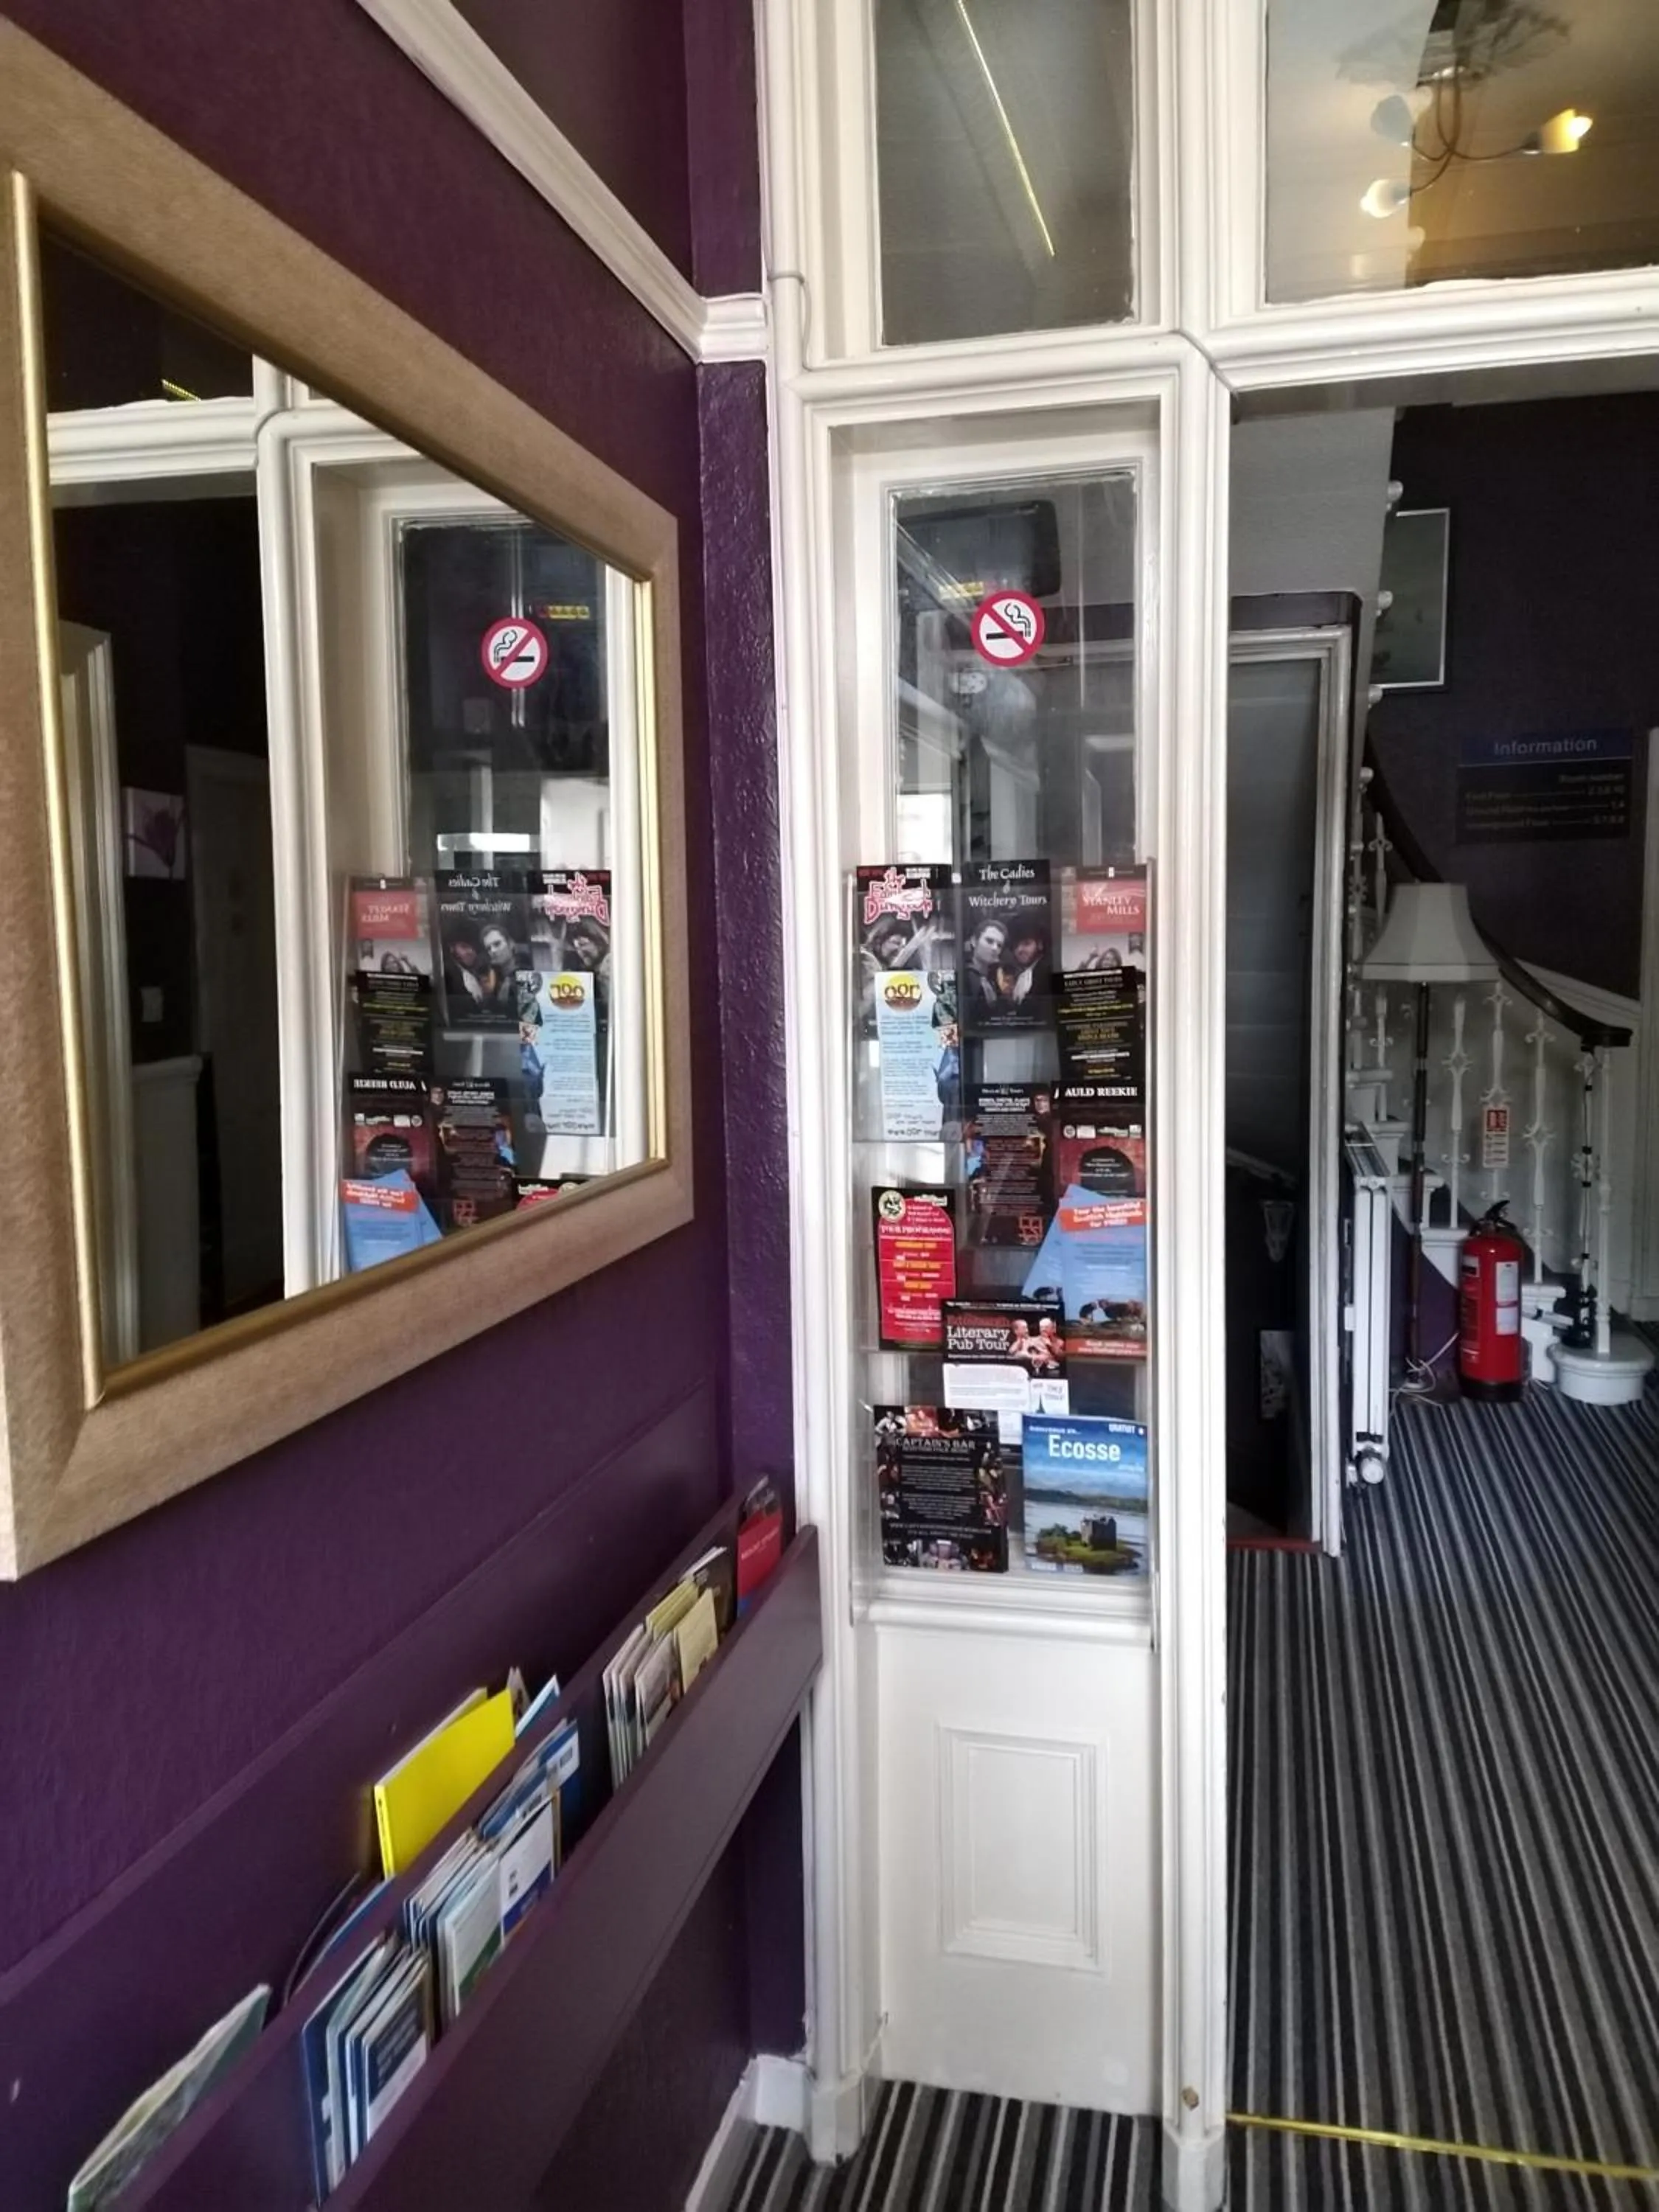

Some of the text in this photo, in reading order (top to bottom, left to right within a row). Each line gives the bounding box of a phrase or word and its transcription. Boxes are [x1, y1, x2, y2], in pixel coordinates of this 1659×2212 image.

[1493, 737, 1598, 756] Information
[978, 863, 1035, 881] The Cadies
[968, 890, 1048, 909] Witchery Tours
[1107, 905, 1141, 915] MILLS
[1064, 1087, 1138, 1097] AULD REEKIE
[947, 1326, 1010, 1341] Literary
[947, 1338, 1009, 1351] Pub Tour
[1048, 1434, 1121, 1462] Ecosse
